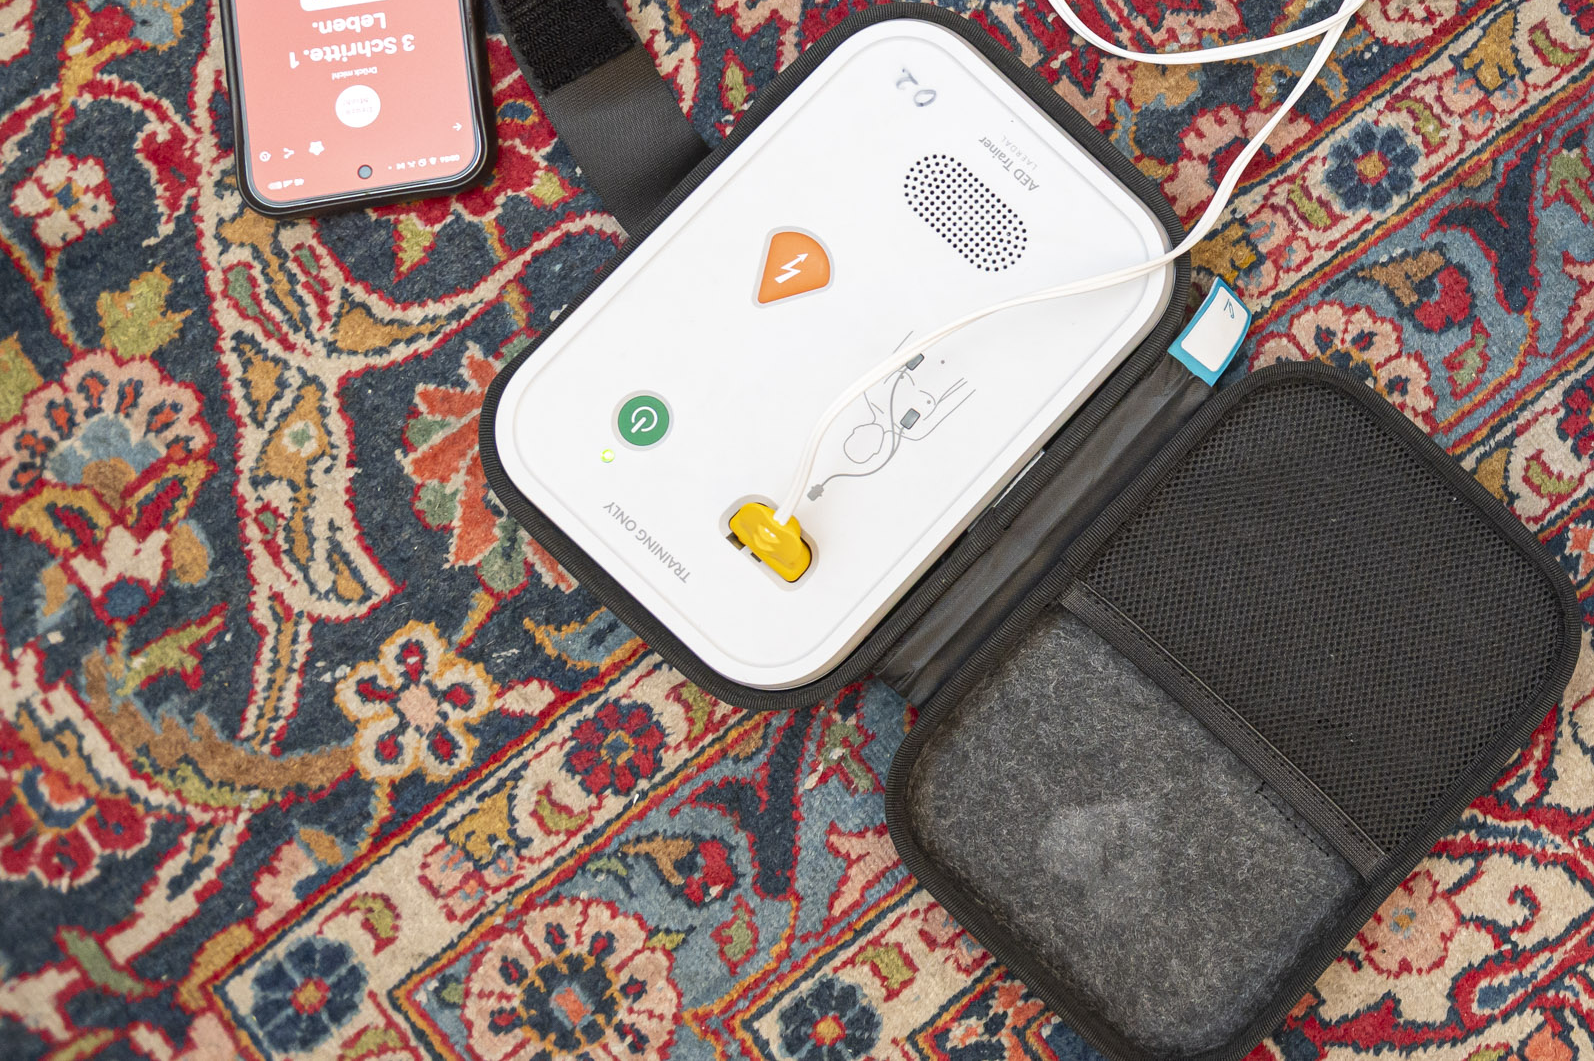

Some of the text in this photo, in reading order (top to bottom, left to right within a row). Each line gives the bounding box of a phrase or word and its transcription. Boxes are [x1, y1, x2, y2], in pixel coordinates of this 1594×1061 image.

[311, 12, 387, 35] Leben.
[288, 33, 416, 70] 3 Schritte. 1
[978, 136, 1040, 191] AED Trainer
[1002, 135, 1037, 170] LAERDAL
[603, 502, 691, 584] TRAINING ONLY
